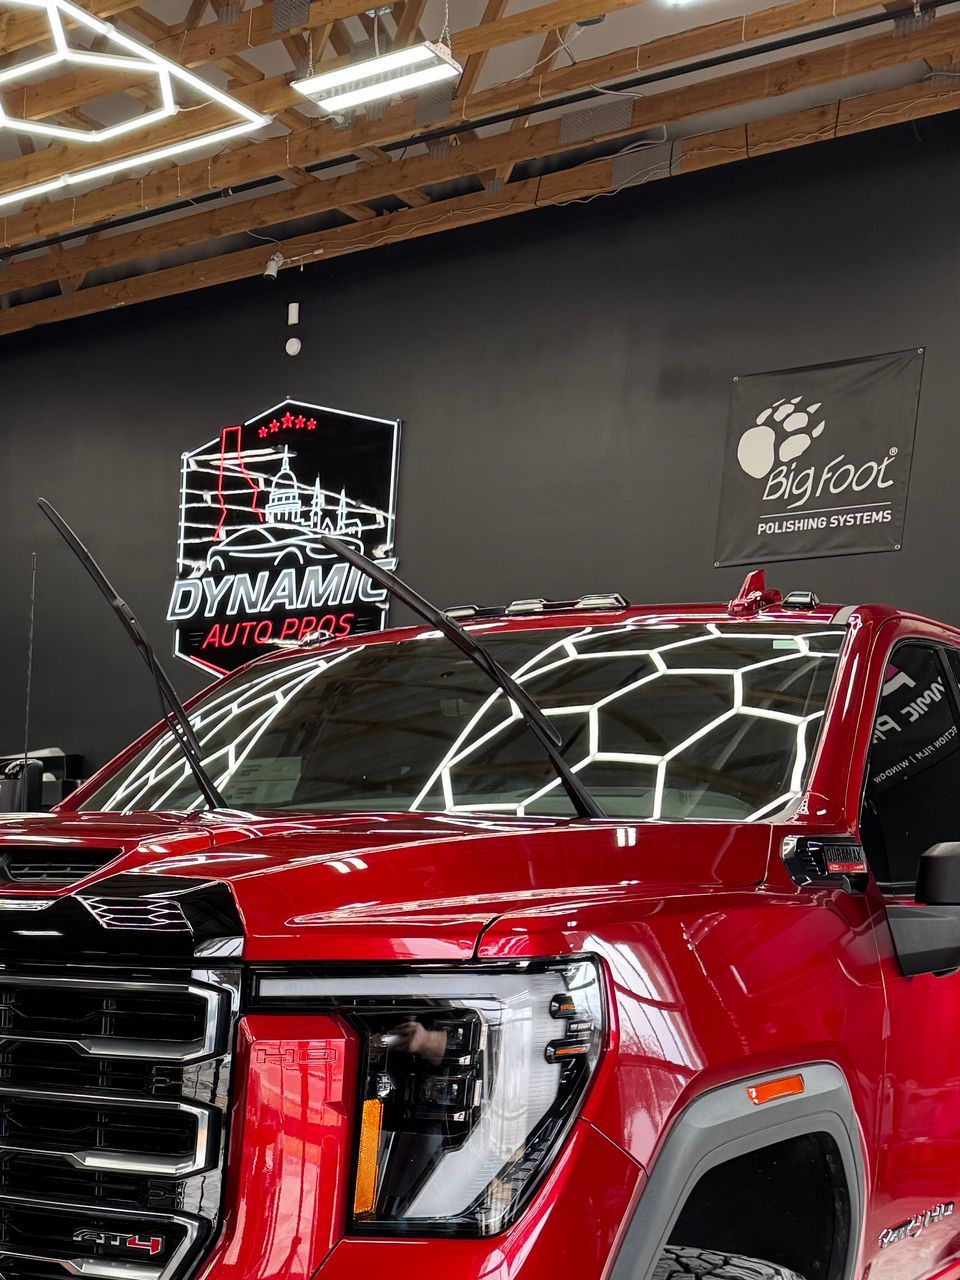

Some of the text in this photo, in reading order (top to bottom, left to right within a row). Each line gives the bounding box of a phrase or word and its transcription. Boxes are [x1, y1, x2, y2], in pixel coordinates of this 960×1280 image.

[757, 509, 892, 536] POLISHING SYSTEMS
[166, 557, 399, 621] DYNAMIC
[201, 613, 355, 649] AUTO PROS
[72, 1229, 162, 1255] AT4
